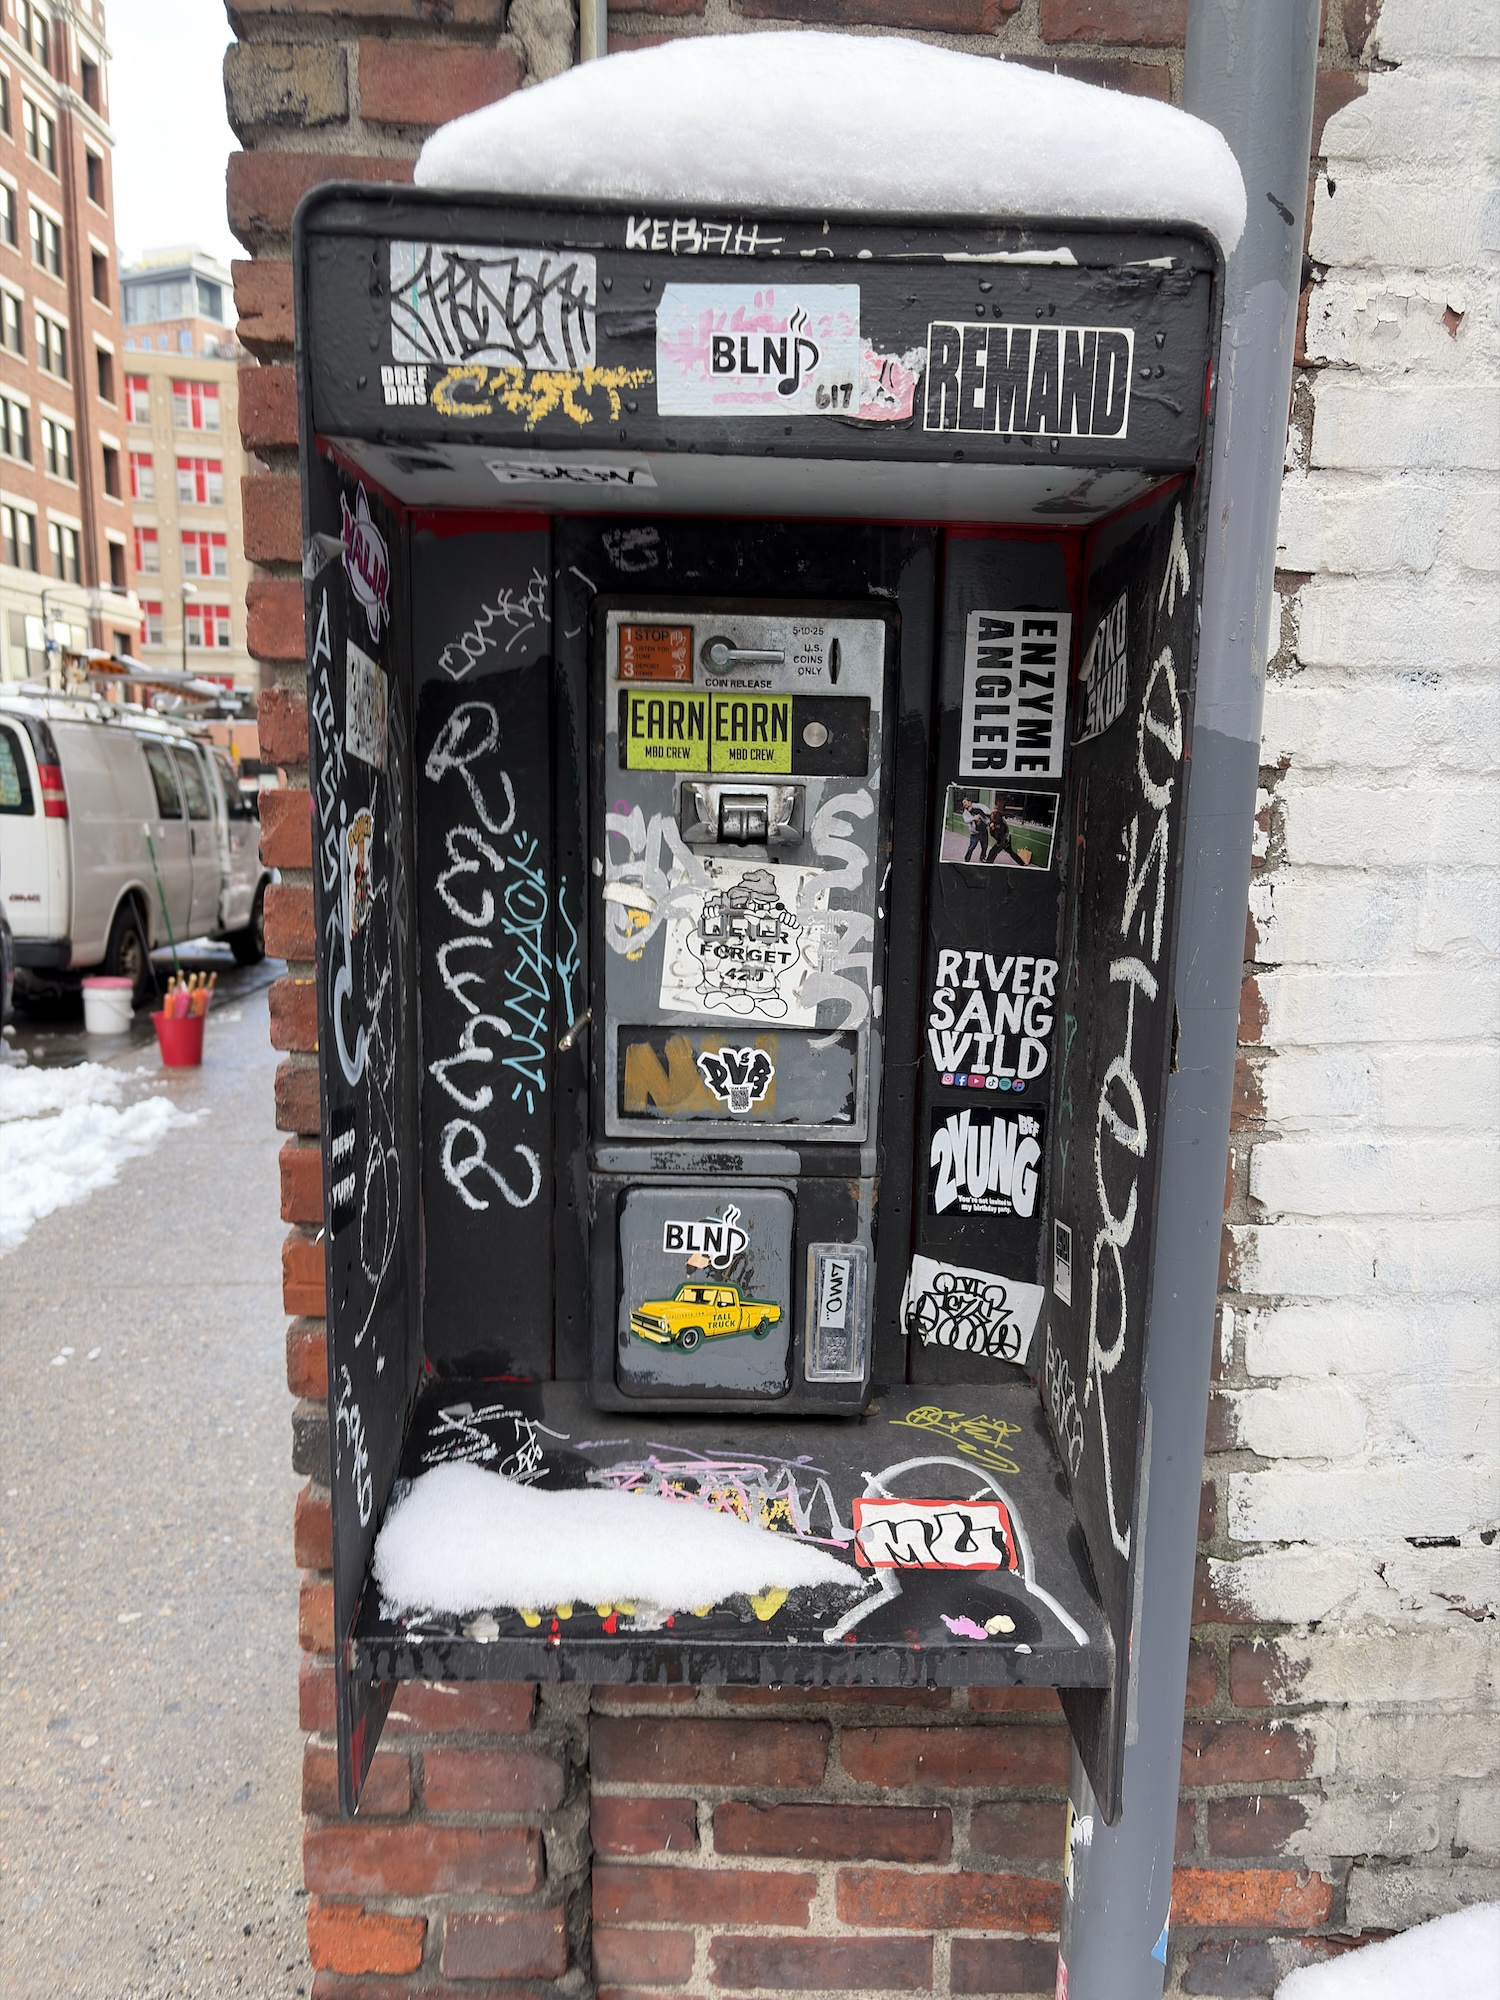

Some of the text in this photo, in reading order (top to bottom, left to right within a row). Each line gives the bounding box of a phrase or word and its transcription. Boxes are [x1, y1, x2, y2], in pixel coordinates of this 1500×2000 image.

[928, 325, 1129, 436] REMAND
[384, 385, 427, 405] DMS
[815, 383, 853, 409] 617
[625, 628, 669, 642] 1 STOP
[624, 644, 634, 659] 2
[804, 644, 823, 652] U.S.
[793, 655, 823, 664] COINS
[624, 661, 634, 677] 3
[798, 667, 822, 676] ONLY
[705, 678, 773, 689] COIN RELEASE
[971, 616, 1015, 771] ANGLER
[1015, 619, 1058, 773] ENZYME
[632, 699, 705, 741] EARN
[716, 702, 788, 743] EARN
[645, 746, 691, 759] MBD CREW
[729, 749, 774, 761] MBD CREW
[700, 943, 792, 965] FORGET
[936, 949, 1059, 996] RIVER
[929, 987, 1054, 1036] SANG
[928, 1027, 1049, 1080] WILD
[930, 1109, 1041, 1217] 2YUNG BFF
[961, 1204, 972, 1213] my
[973, 1204, 998, 1213] birthday
[707, 1320, 736, 1329] TRUCK
[712, 1312, 732, 1321] TALL
